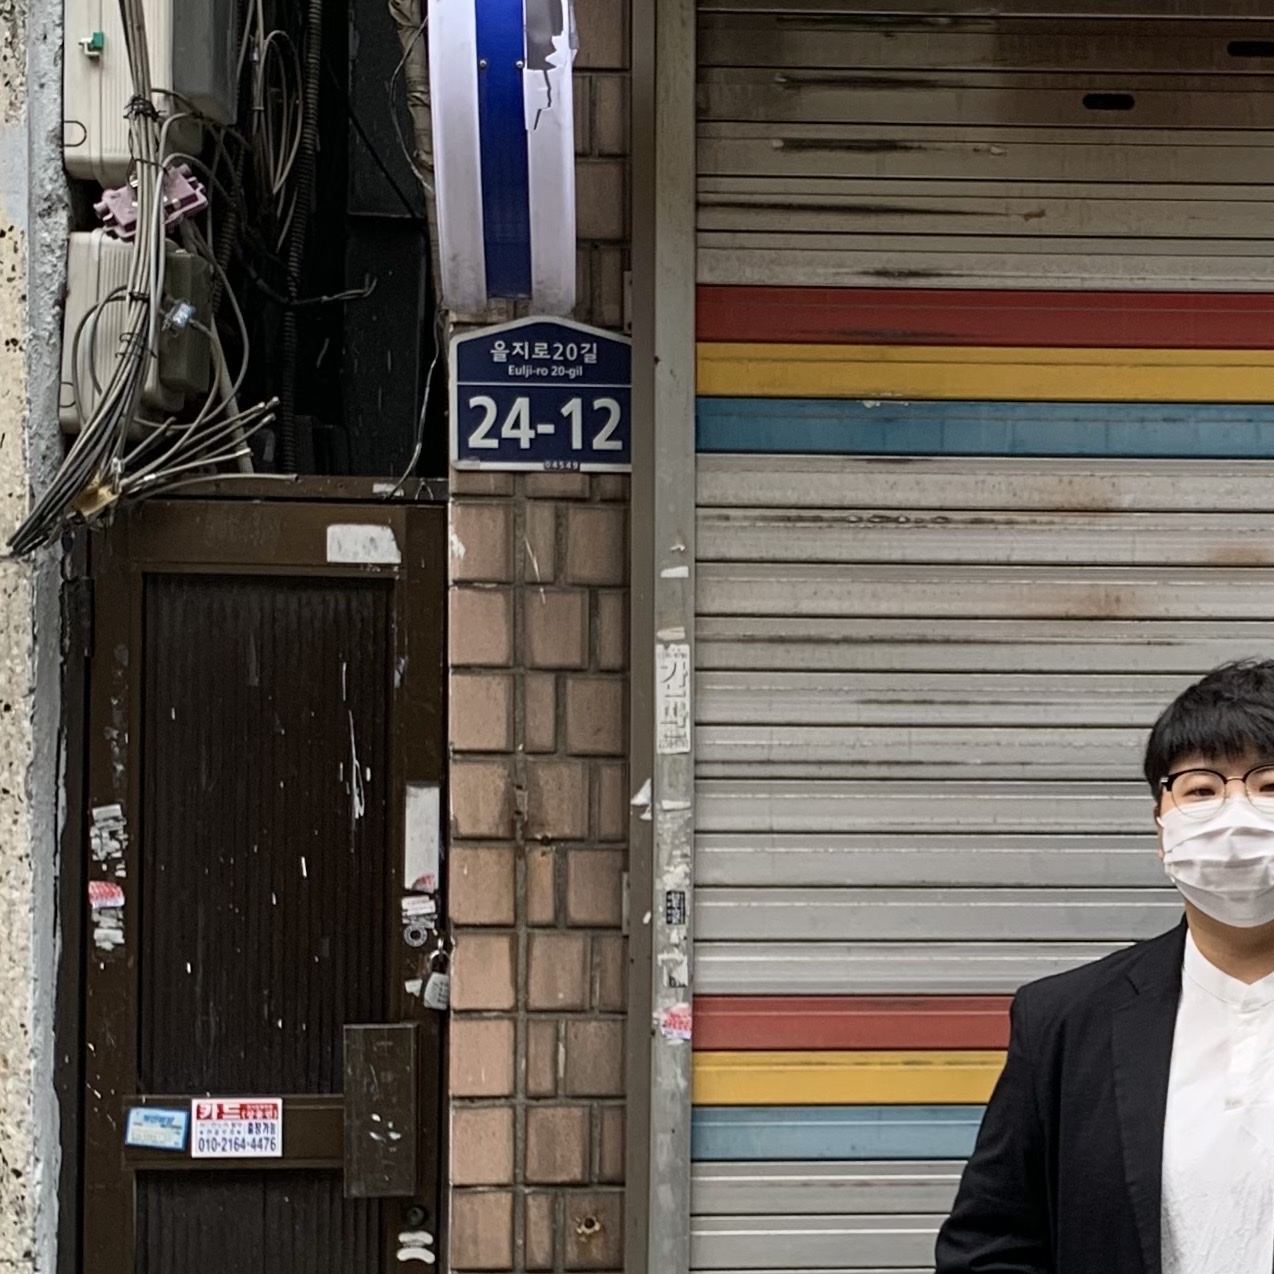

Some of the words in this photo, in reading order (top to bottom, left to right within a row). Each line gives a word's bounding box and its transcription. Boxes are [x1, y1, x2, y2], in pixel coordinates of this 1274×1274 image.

[490, 340, 597, 363] 을지로20길
[508, 365, 548, 378] Eulji-ro
[551, 365, 583, 379] 20-gil
[468, 395, 623, 450] 24-12
